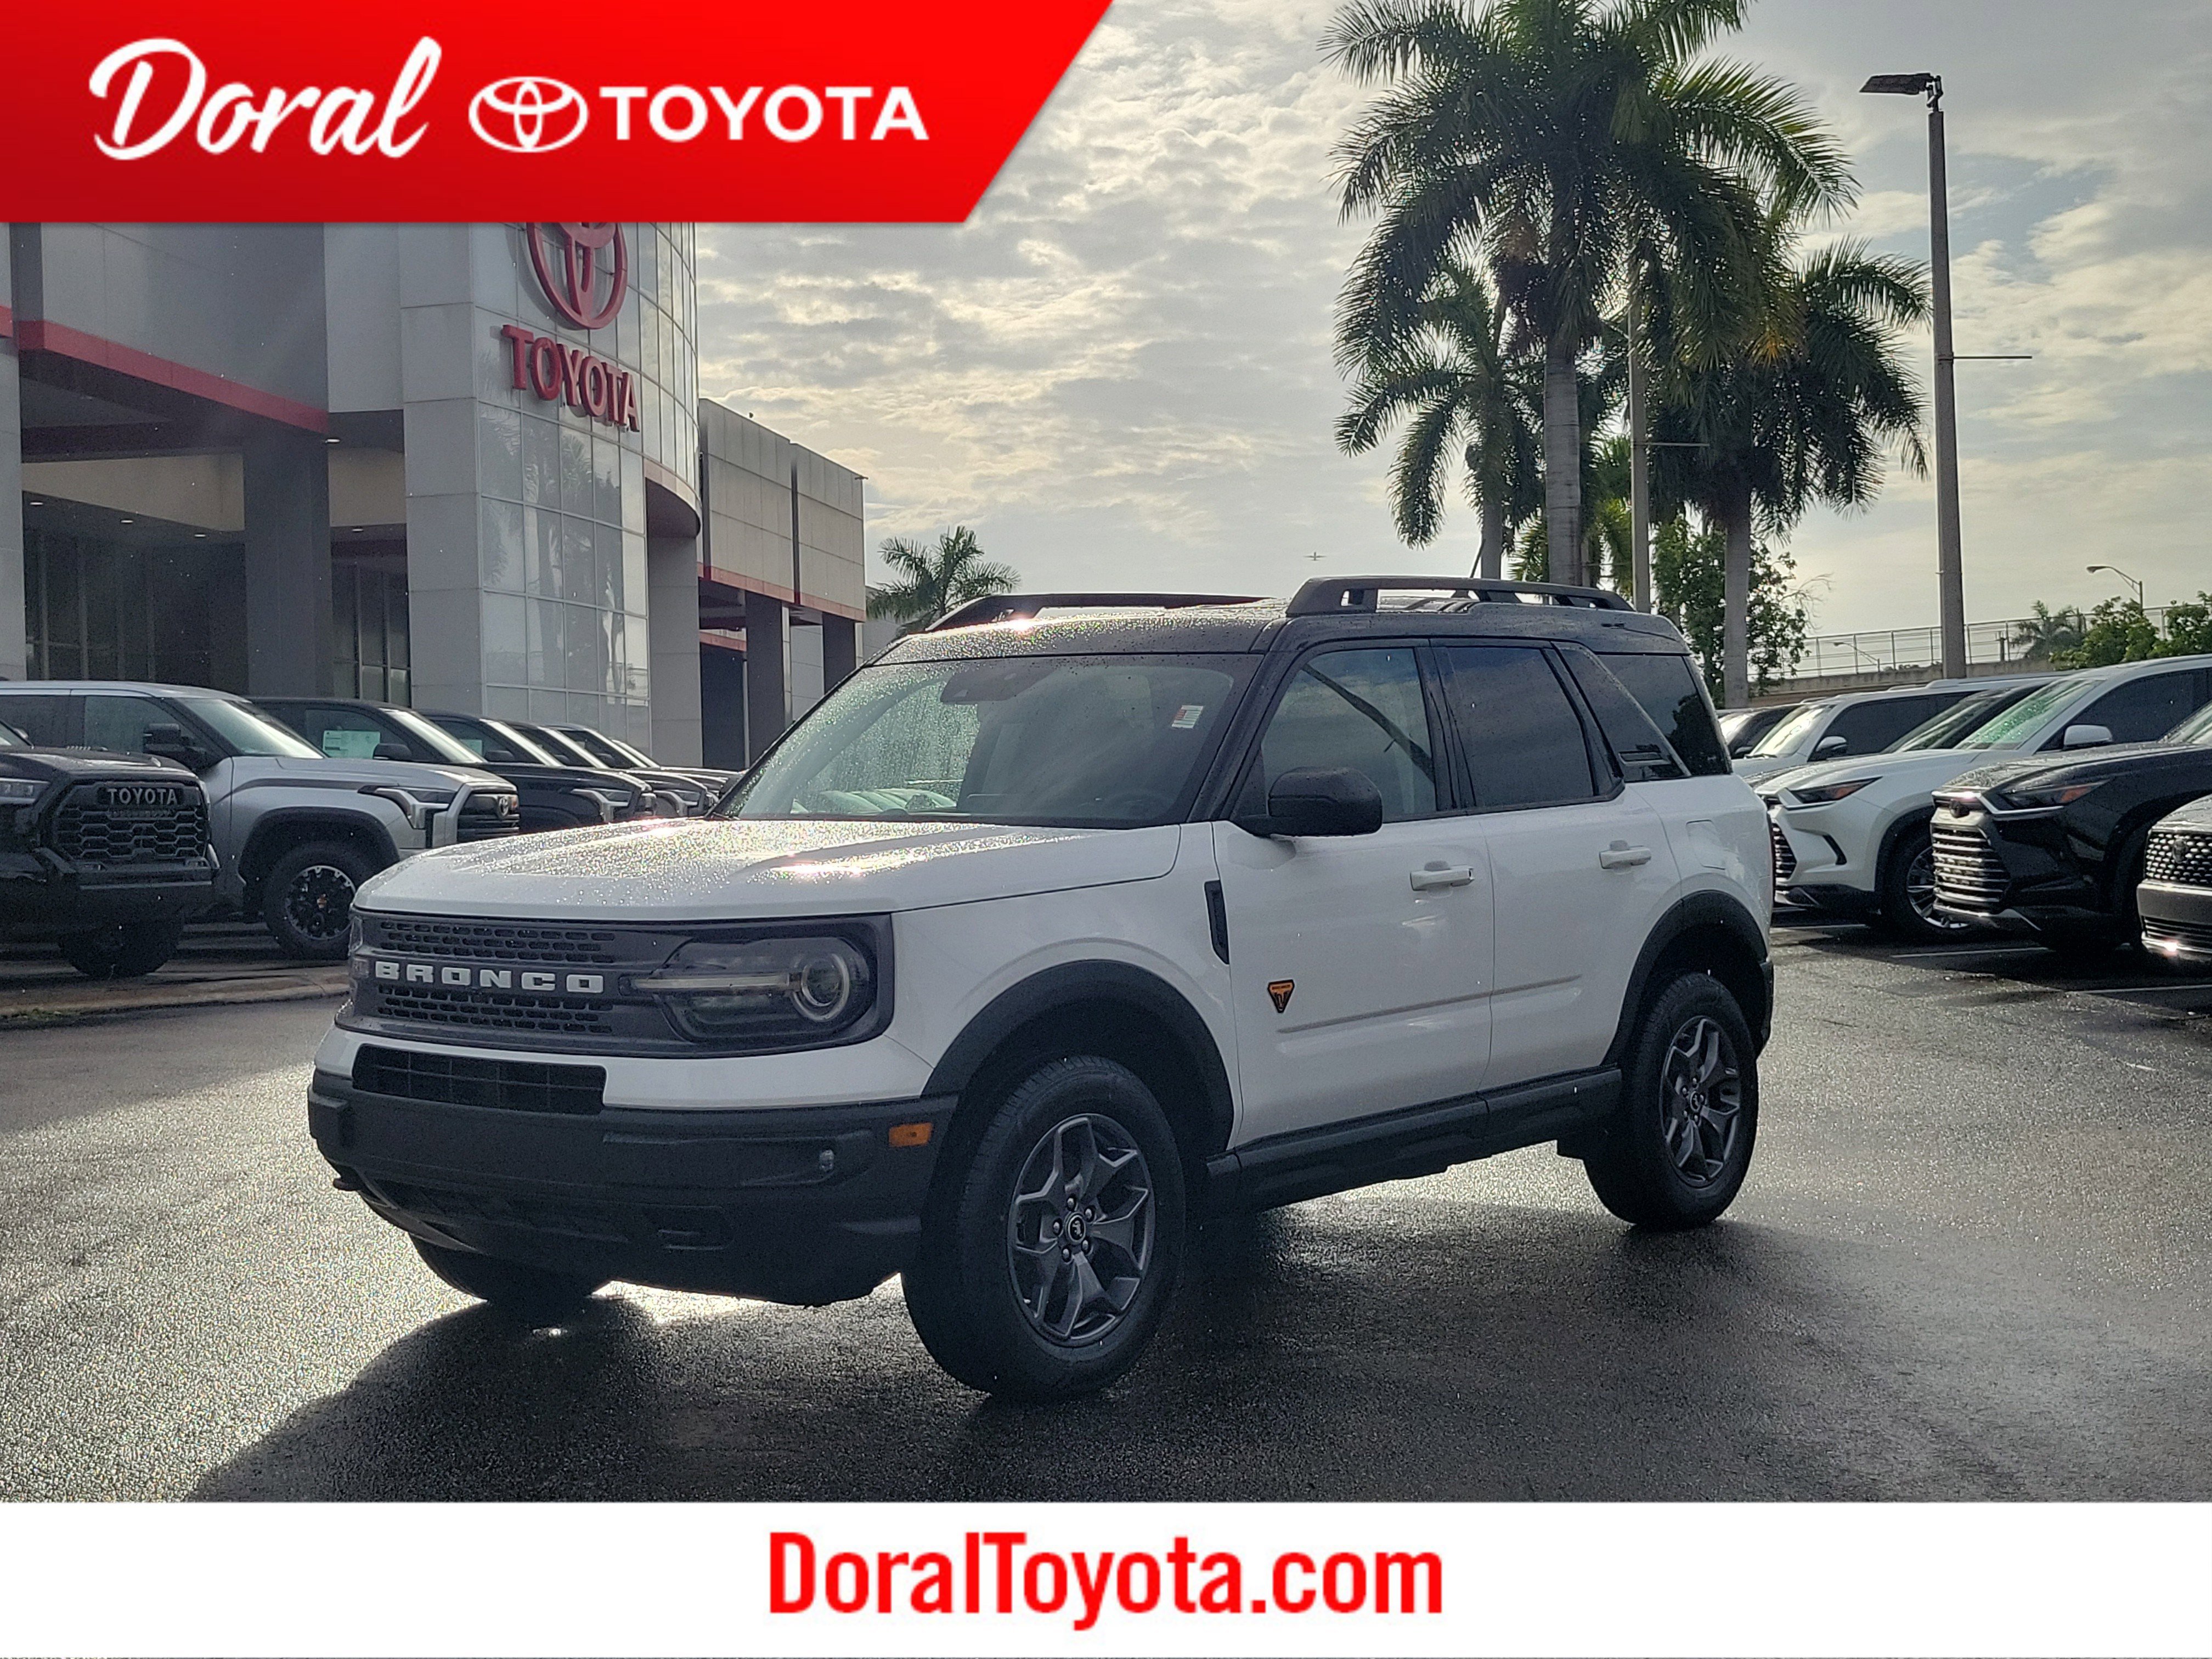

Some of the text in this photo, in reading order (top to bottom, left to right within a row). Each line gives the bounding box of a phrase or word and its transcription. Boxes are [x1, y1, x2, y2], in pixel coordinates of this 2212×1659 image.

[501, 324, 640, 432] TOYOTA
[106, 787, 178, 805] TOYOTA
[375, 961, 604, 994] BRONCO
